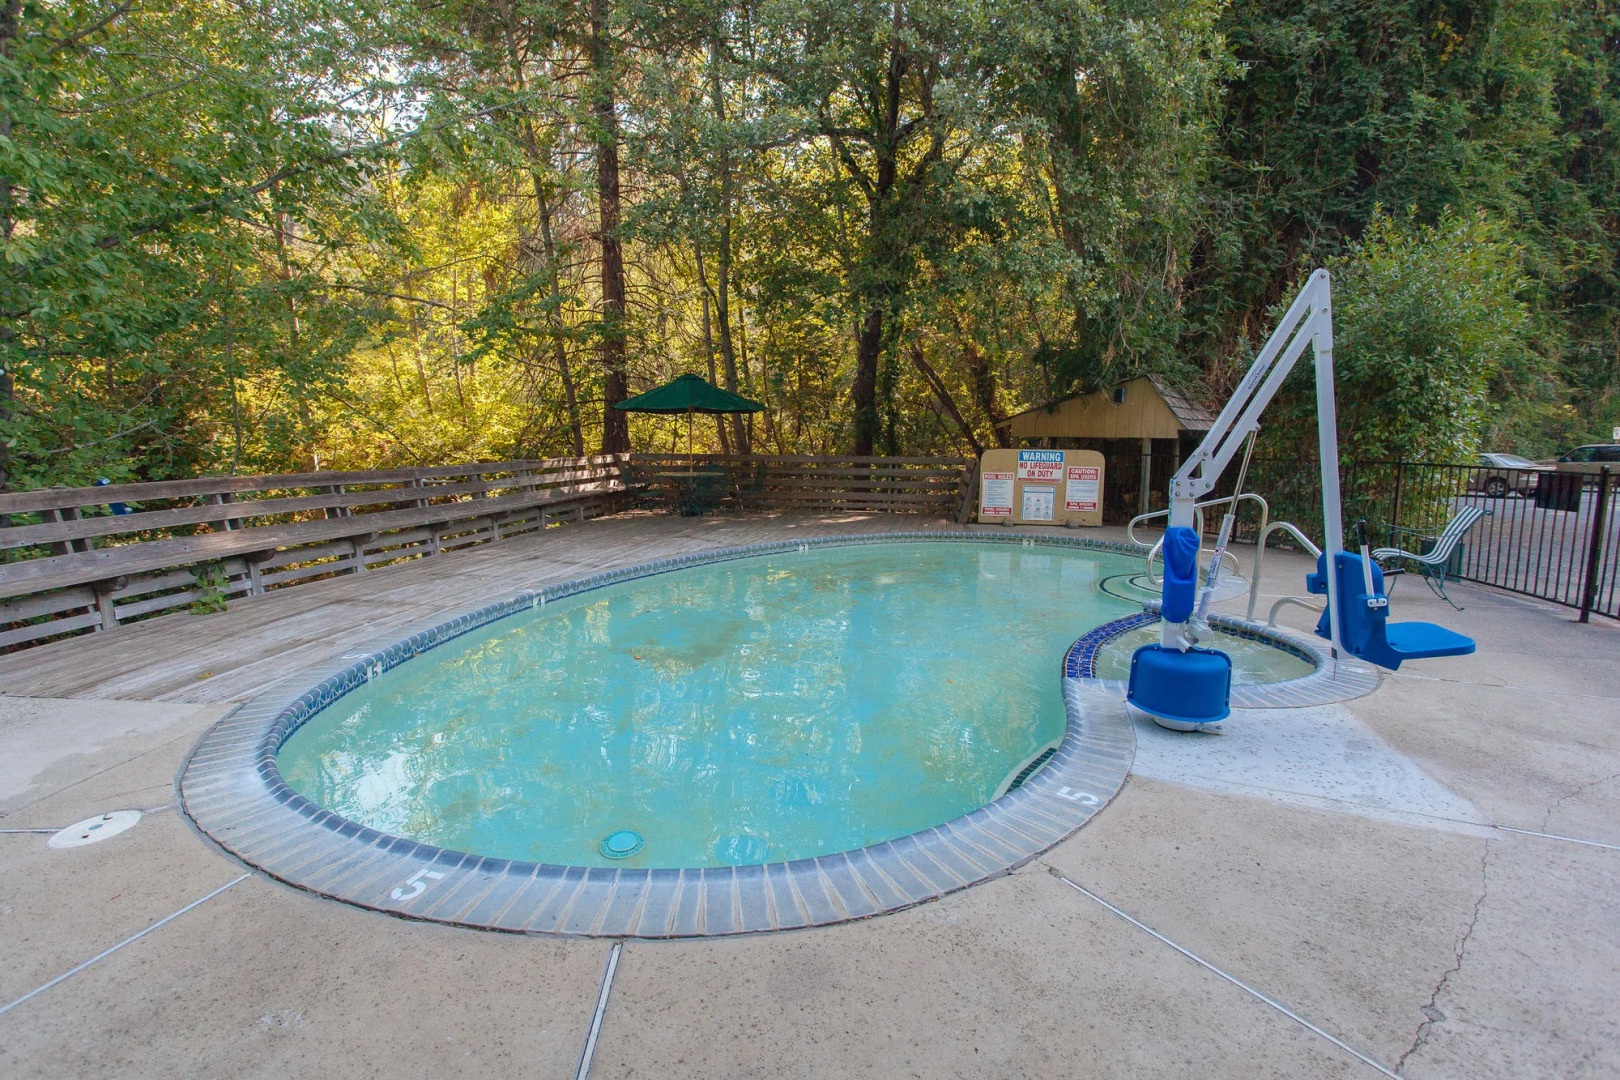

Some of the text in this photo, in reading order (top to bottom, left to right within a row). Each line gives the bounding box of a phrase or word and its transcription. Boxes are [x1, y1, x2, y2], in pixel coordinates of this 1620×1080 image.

[1022, 451, 1061, 461] WARNING
[1019, 461, 1063, 470] NO LIFEGUARD
[1026, 469, 1054, 478] ON DUTY
[1055, 786, 1099, 805] 5
[391, 871, 446, 901] 5
